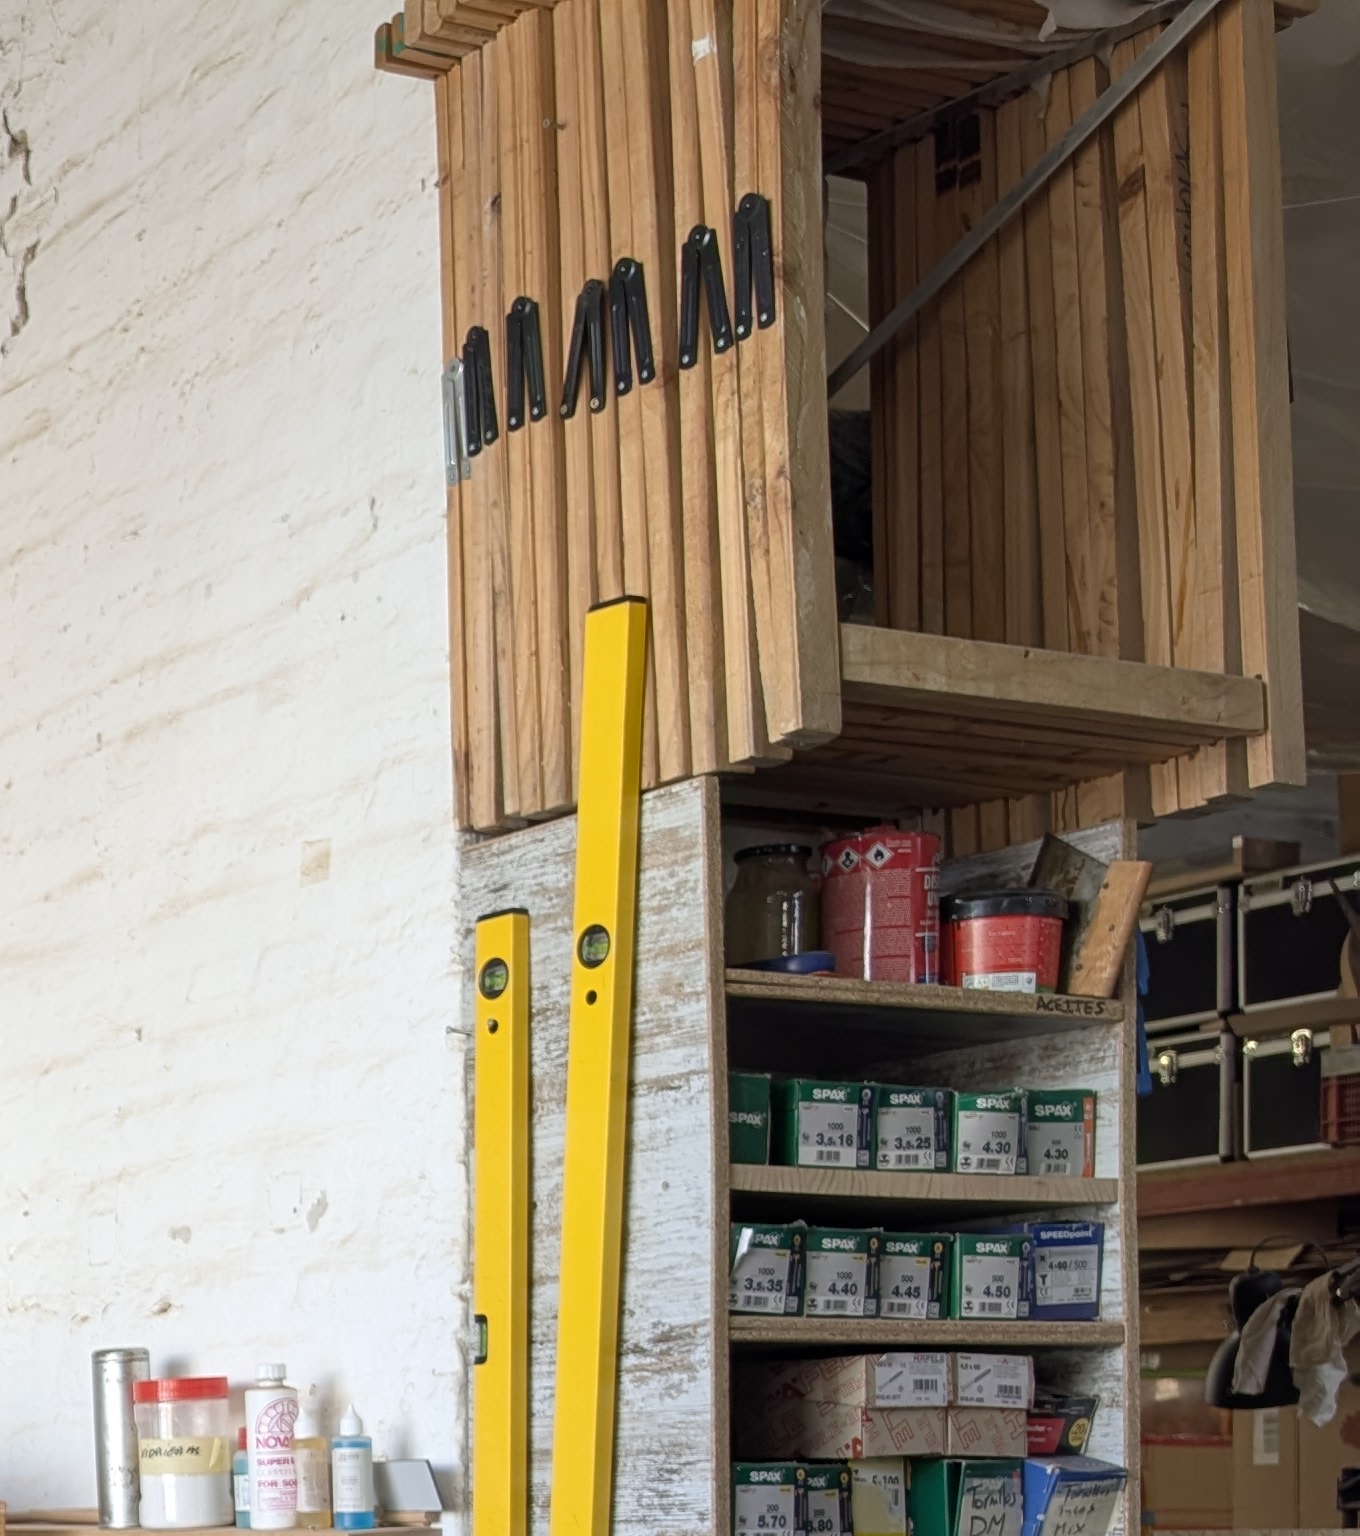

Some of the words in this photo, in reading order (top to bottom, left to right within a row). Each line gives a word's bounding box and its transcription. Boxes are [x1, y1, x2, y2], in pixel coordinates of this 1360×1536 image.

[1036, 996, 1105, 1015] ACEITES
[812, 1088, 846, 1100] SPAX
[889, 1093, 922, 1105] SPAX
[976, 1098, 1010, 1109] SPAX
[1034, 1104, 1072, 1117] SPAX
[730, 1111, 763, 1126] SPAX
[821, 1238, 856, 1250] SPAX
[886, 1241, 919, 1254] SPAX
[975, 1242, 1009, 1254] SPAX
[256, 1457, 289, 1466] SUPER
[750, 1471, 781, 1483] SPAX
[808, 1477, 827, 1488] PAX
[258, 1479, 278, 1488] FOR
